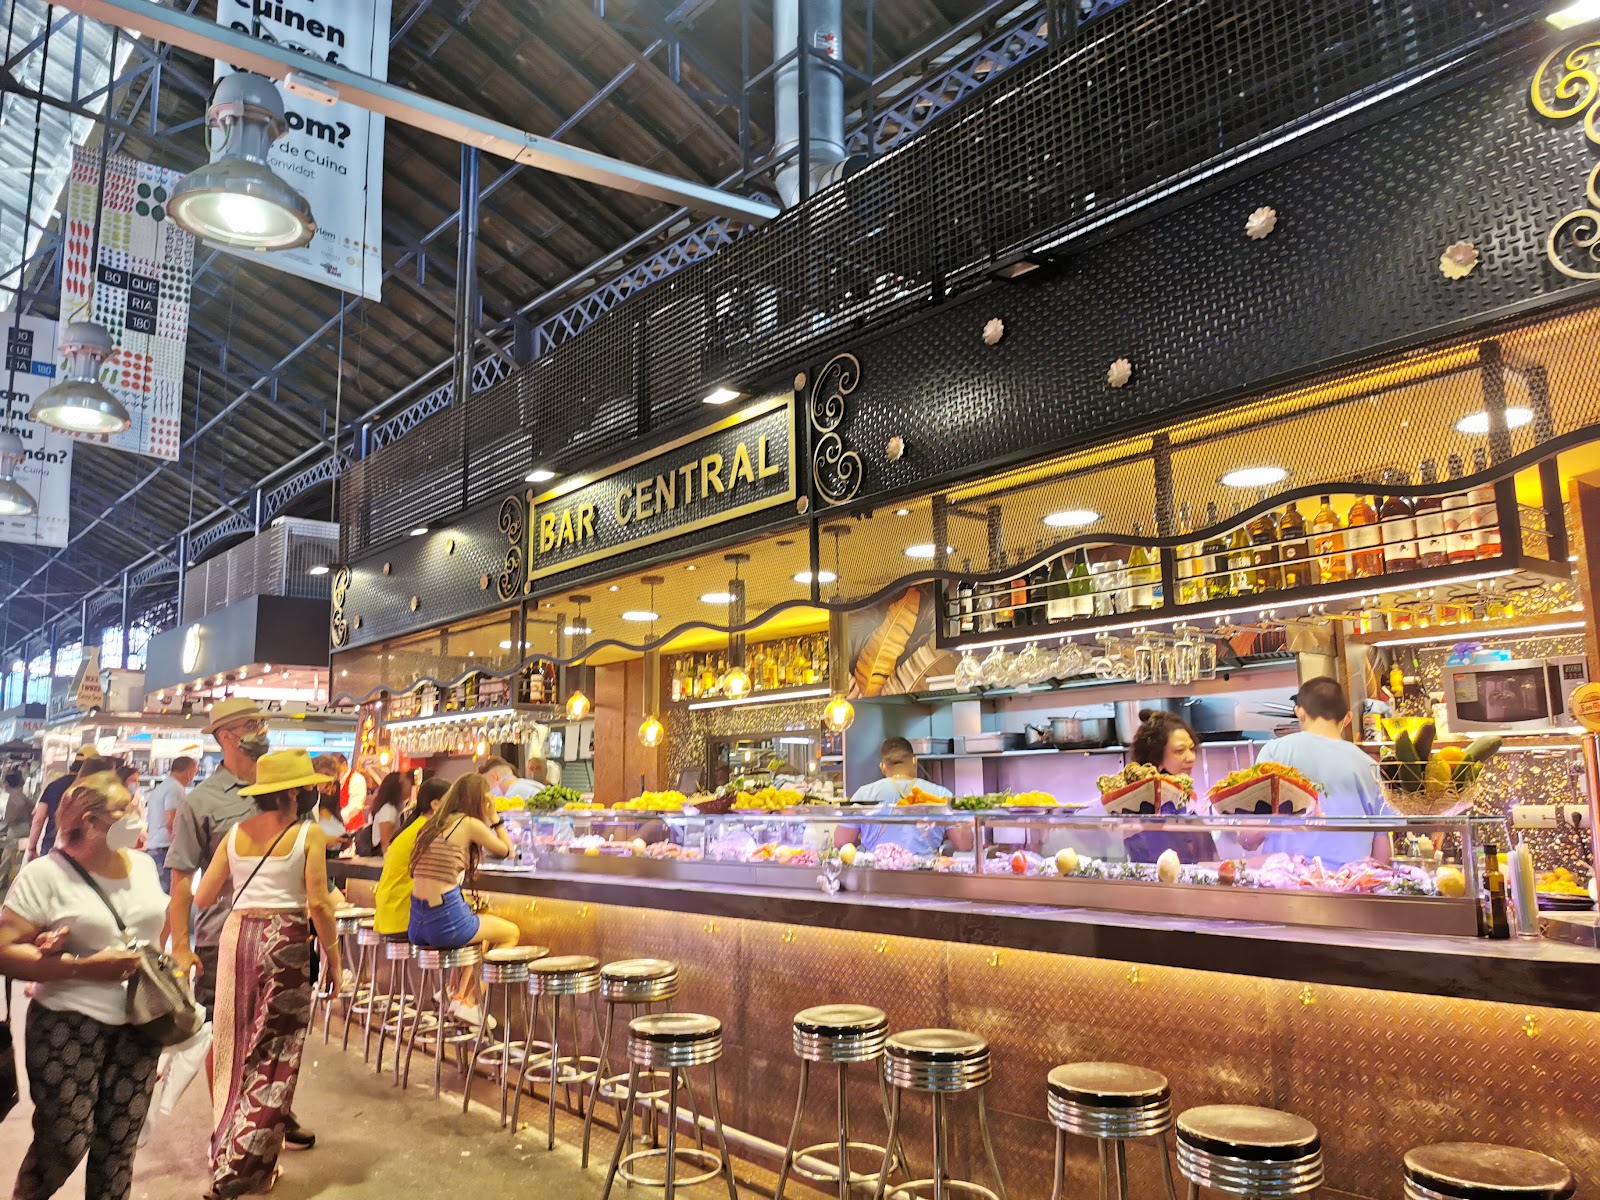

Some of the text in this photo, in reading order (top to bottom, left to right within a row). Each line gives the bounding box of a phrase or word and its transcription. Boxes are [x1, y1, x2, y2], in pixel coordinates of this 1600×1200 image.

[284, 111, 351, 149] om?
[280, 141, 347, 176] de Cuina
[104, 270, 121, 284] BO
[131, 278, 156, 293] QUE
[131, 297, 153, 312] RIA
[132, 317, 150, 330] 180
[37, 364, 52, 375] 180
[23, 465, 50, 476] Cuina
[539, 435, 780, 553] BAR CENTRAL
